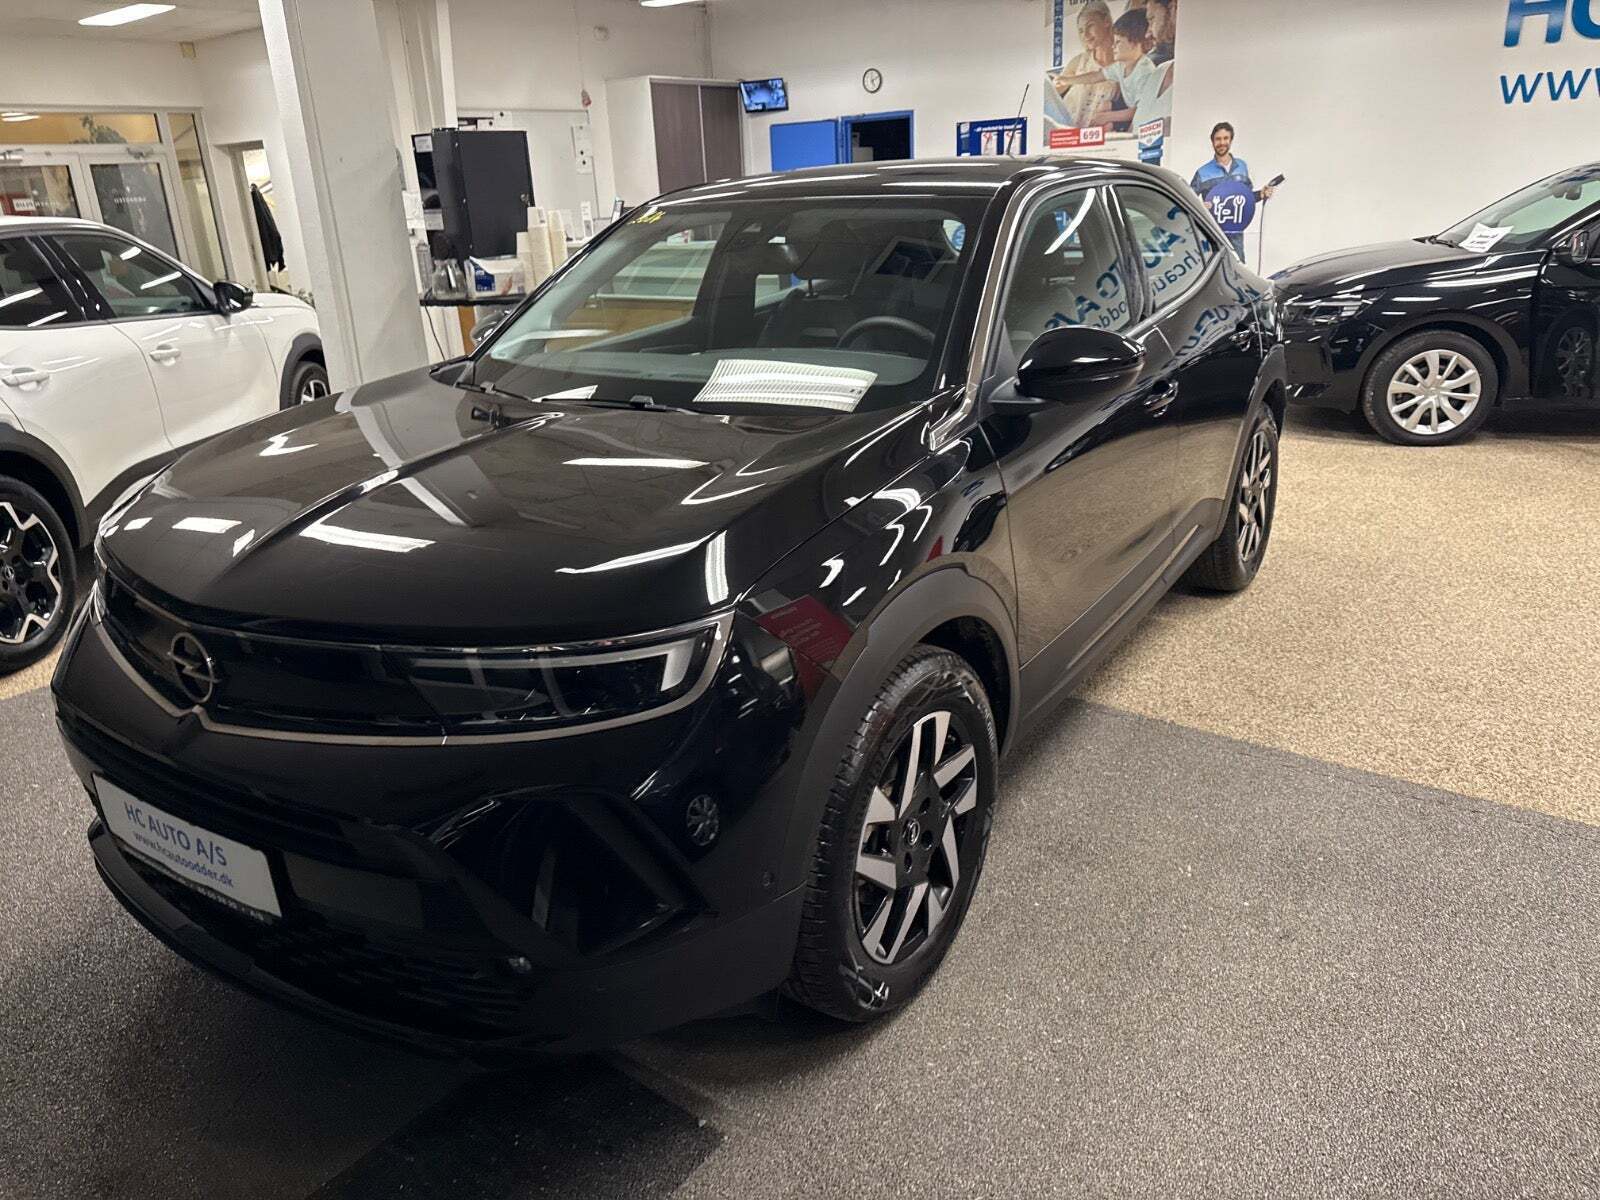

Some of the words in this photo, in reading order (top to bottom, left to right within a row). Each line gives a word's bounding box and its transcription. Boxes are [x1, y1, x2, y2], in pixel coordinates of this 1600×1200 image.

[1503, 0, 1600, 48] H
[1500, 67, 1600, 105] ww
[1083, 129, 1101, 141] 699
[124, 802, 146, 829] HC
[149, 815, 191, 850] AUTO
[196, 838, 228, 867] A/S
